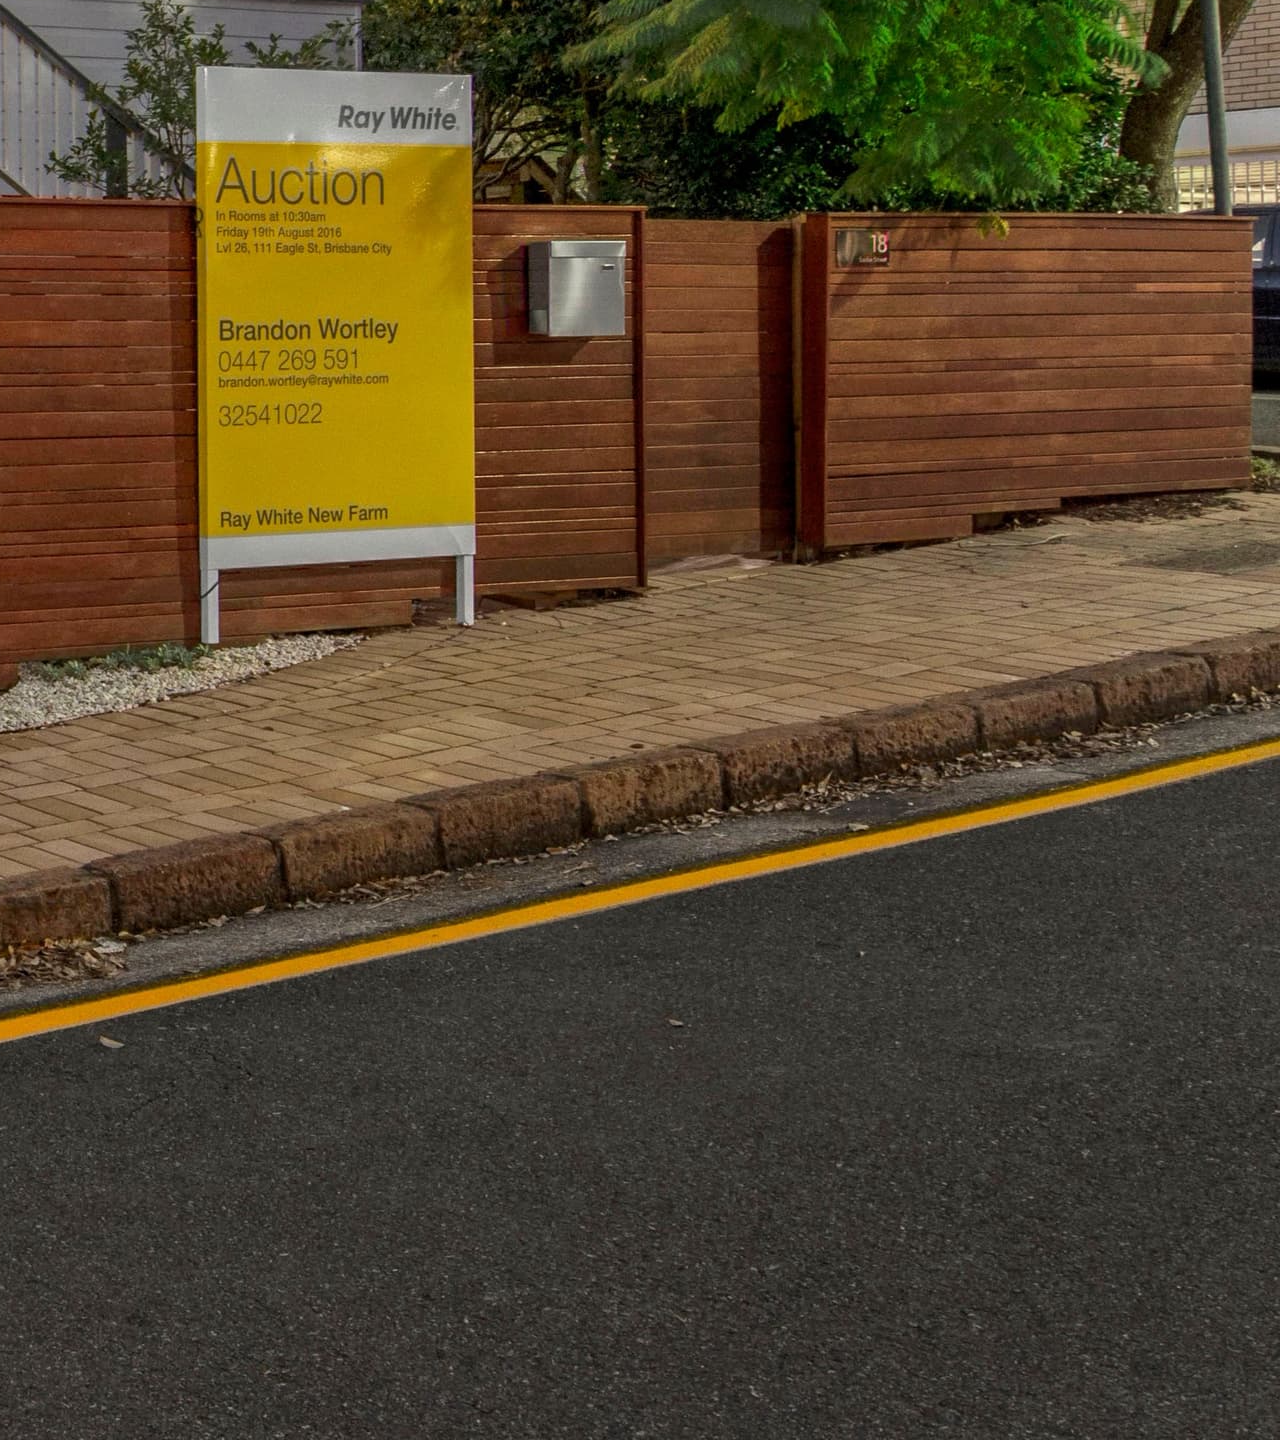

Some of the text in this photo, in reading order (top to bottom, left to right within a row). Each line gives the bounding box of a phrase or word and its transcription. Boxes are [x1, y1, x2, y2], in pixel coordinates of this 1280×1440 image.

[338, 105, 457, 134] Ray White
[215, 156, 385, 205] Auction
[216, 211, 326, 222] In Rooms at 10:30am
[216, 227, 342, 240] Friday 19th August 2016
[871, 234, 889, 253] 18
[216, 243, 392, 256] Lvl 26, 111 Eagle St, Brisbane City
[219, 317, 399, 343] Brandon Wortley
[218, 348, 359, 372] 0447 269 591
[218, 373, 389, 389] brandon.wortley@raywhite.com
[218, 402, 323, 427] 32541022
[220, 505, 388, 531] Ray White New Farm
